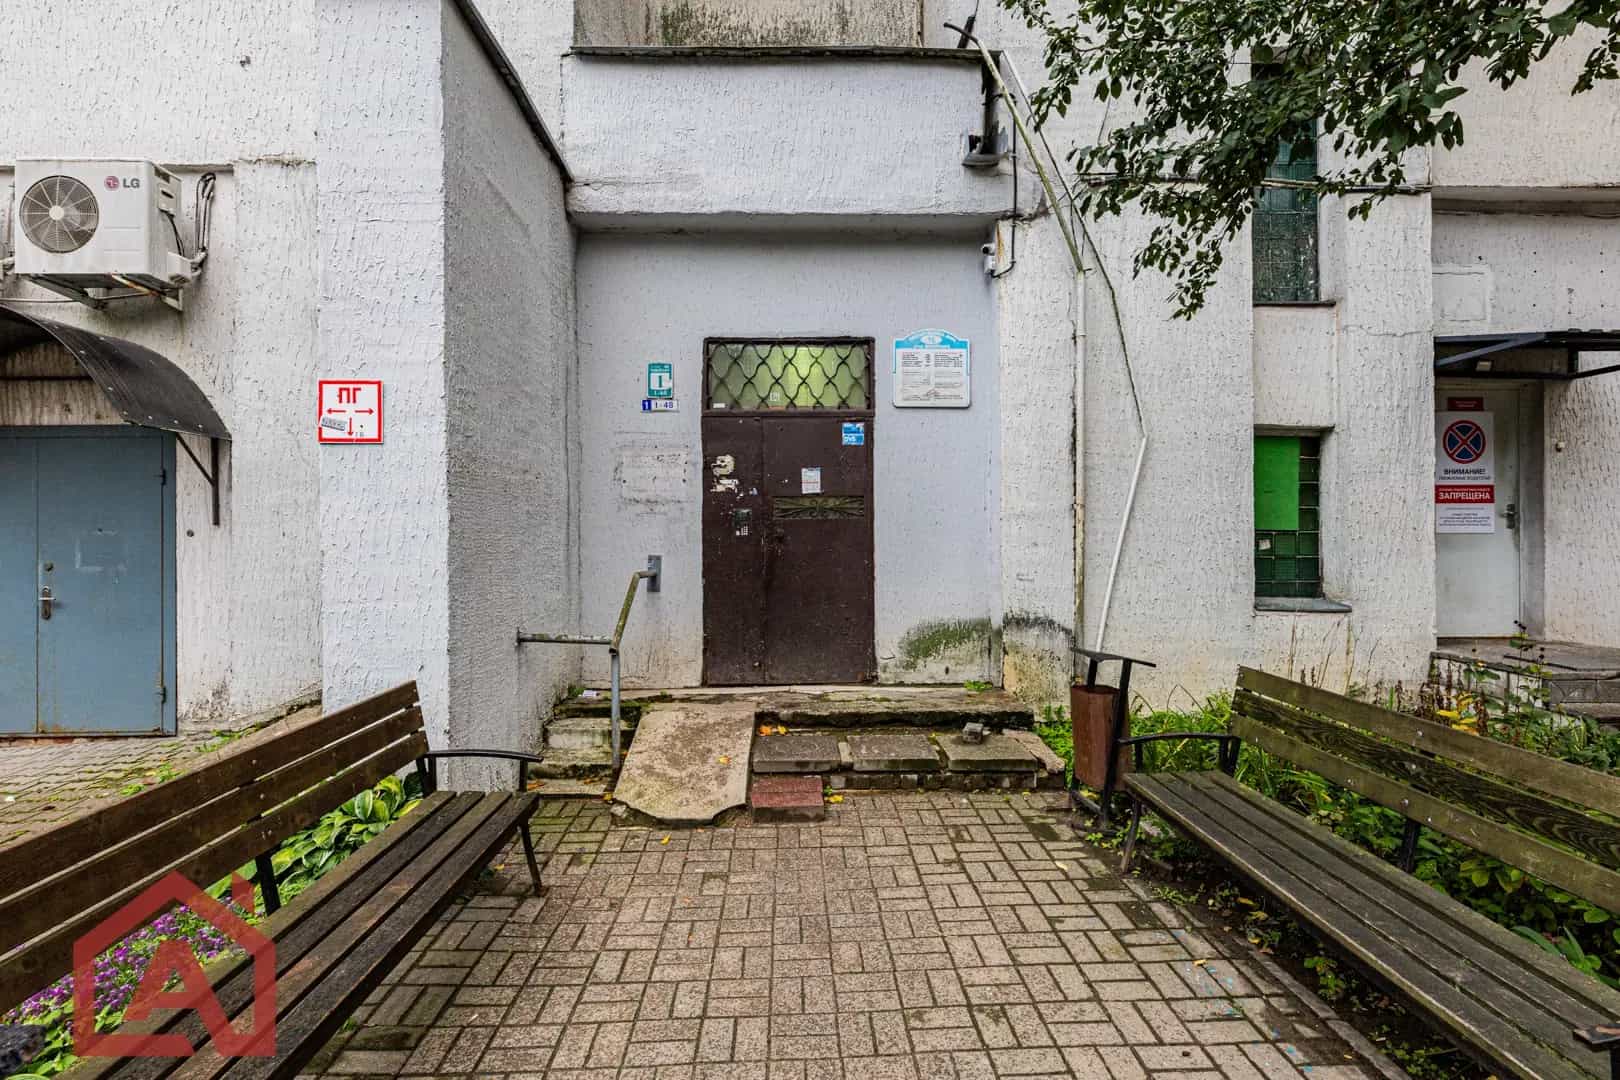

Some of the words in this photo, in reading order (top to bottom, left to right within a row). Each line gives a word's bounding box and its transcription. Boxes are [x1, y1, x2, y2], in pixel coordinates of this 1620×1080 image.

[122, 178, 140, 188] LG
[338, 387, 362, 404] ПГ
[1439, 491, 1490, 500] ЗАПРЕЩЕНА
